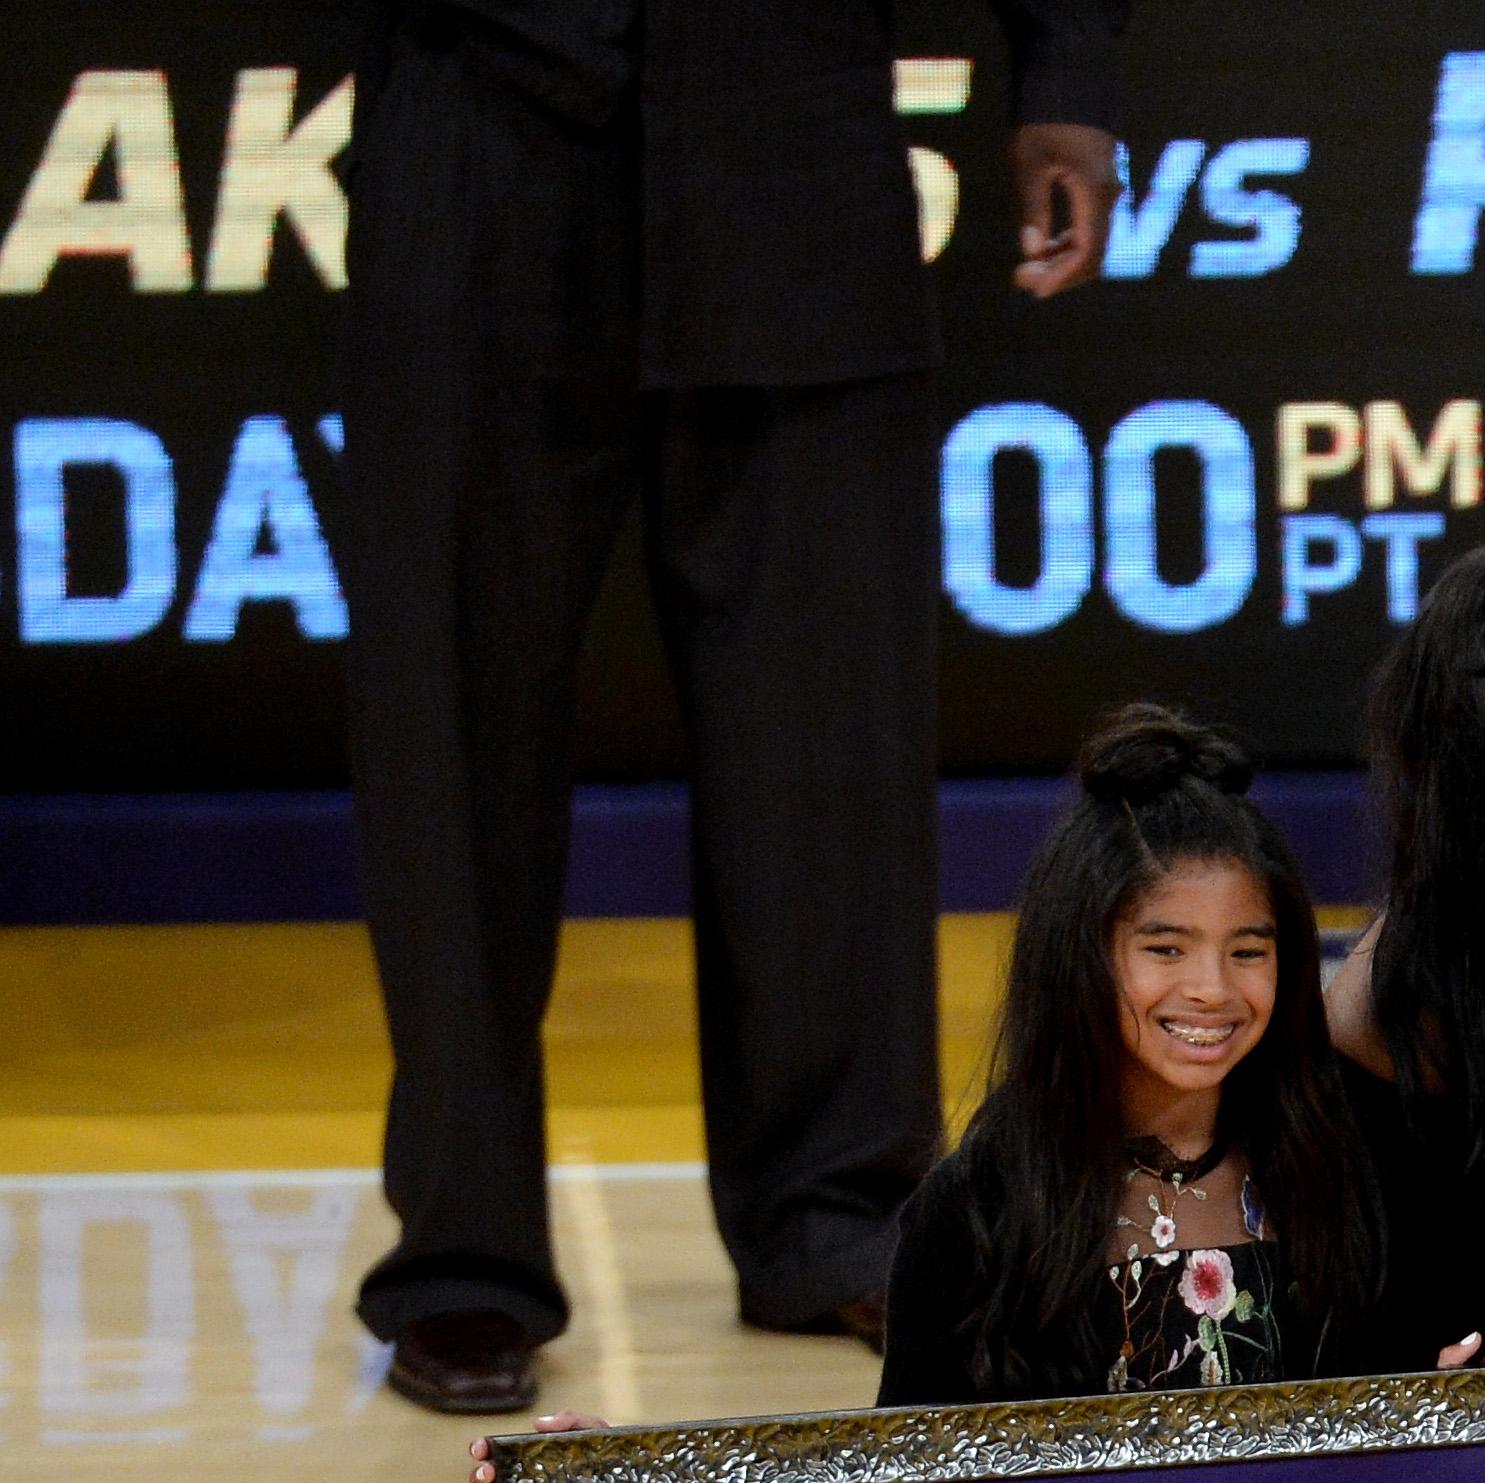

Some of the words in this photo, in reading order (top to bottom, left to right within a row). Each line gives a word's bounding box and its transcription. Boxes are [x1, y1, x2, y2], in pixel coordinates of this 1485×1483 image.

[14, 413, 350, 645] DA
[1276, 400, 1484, 510] PM
[1280, 512, 1446, 627] PT
